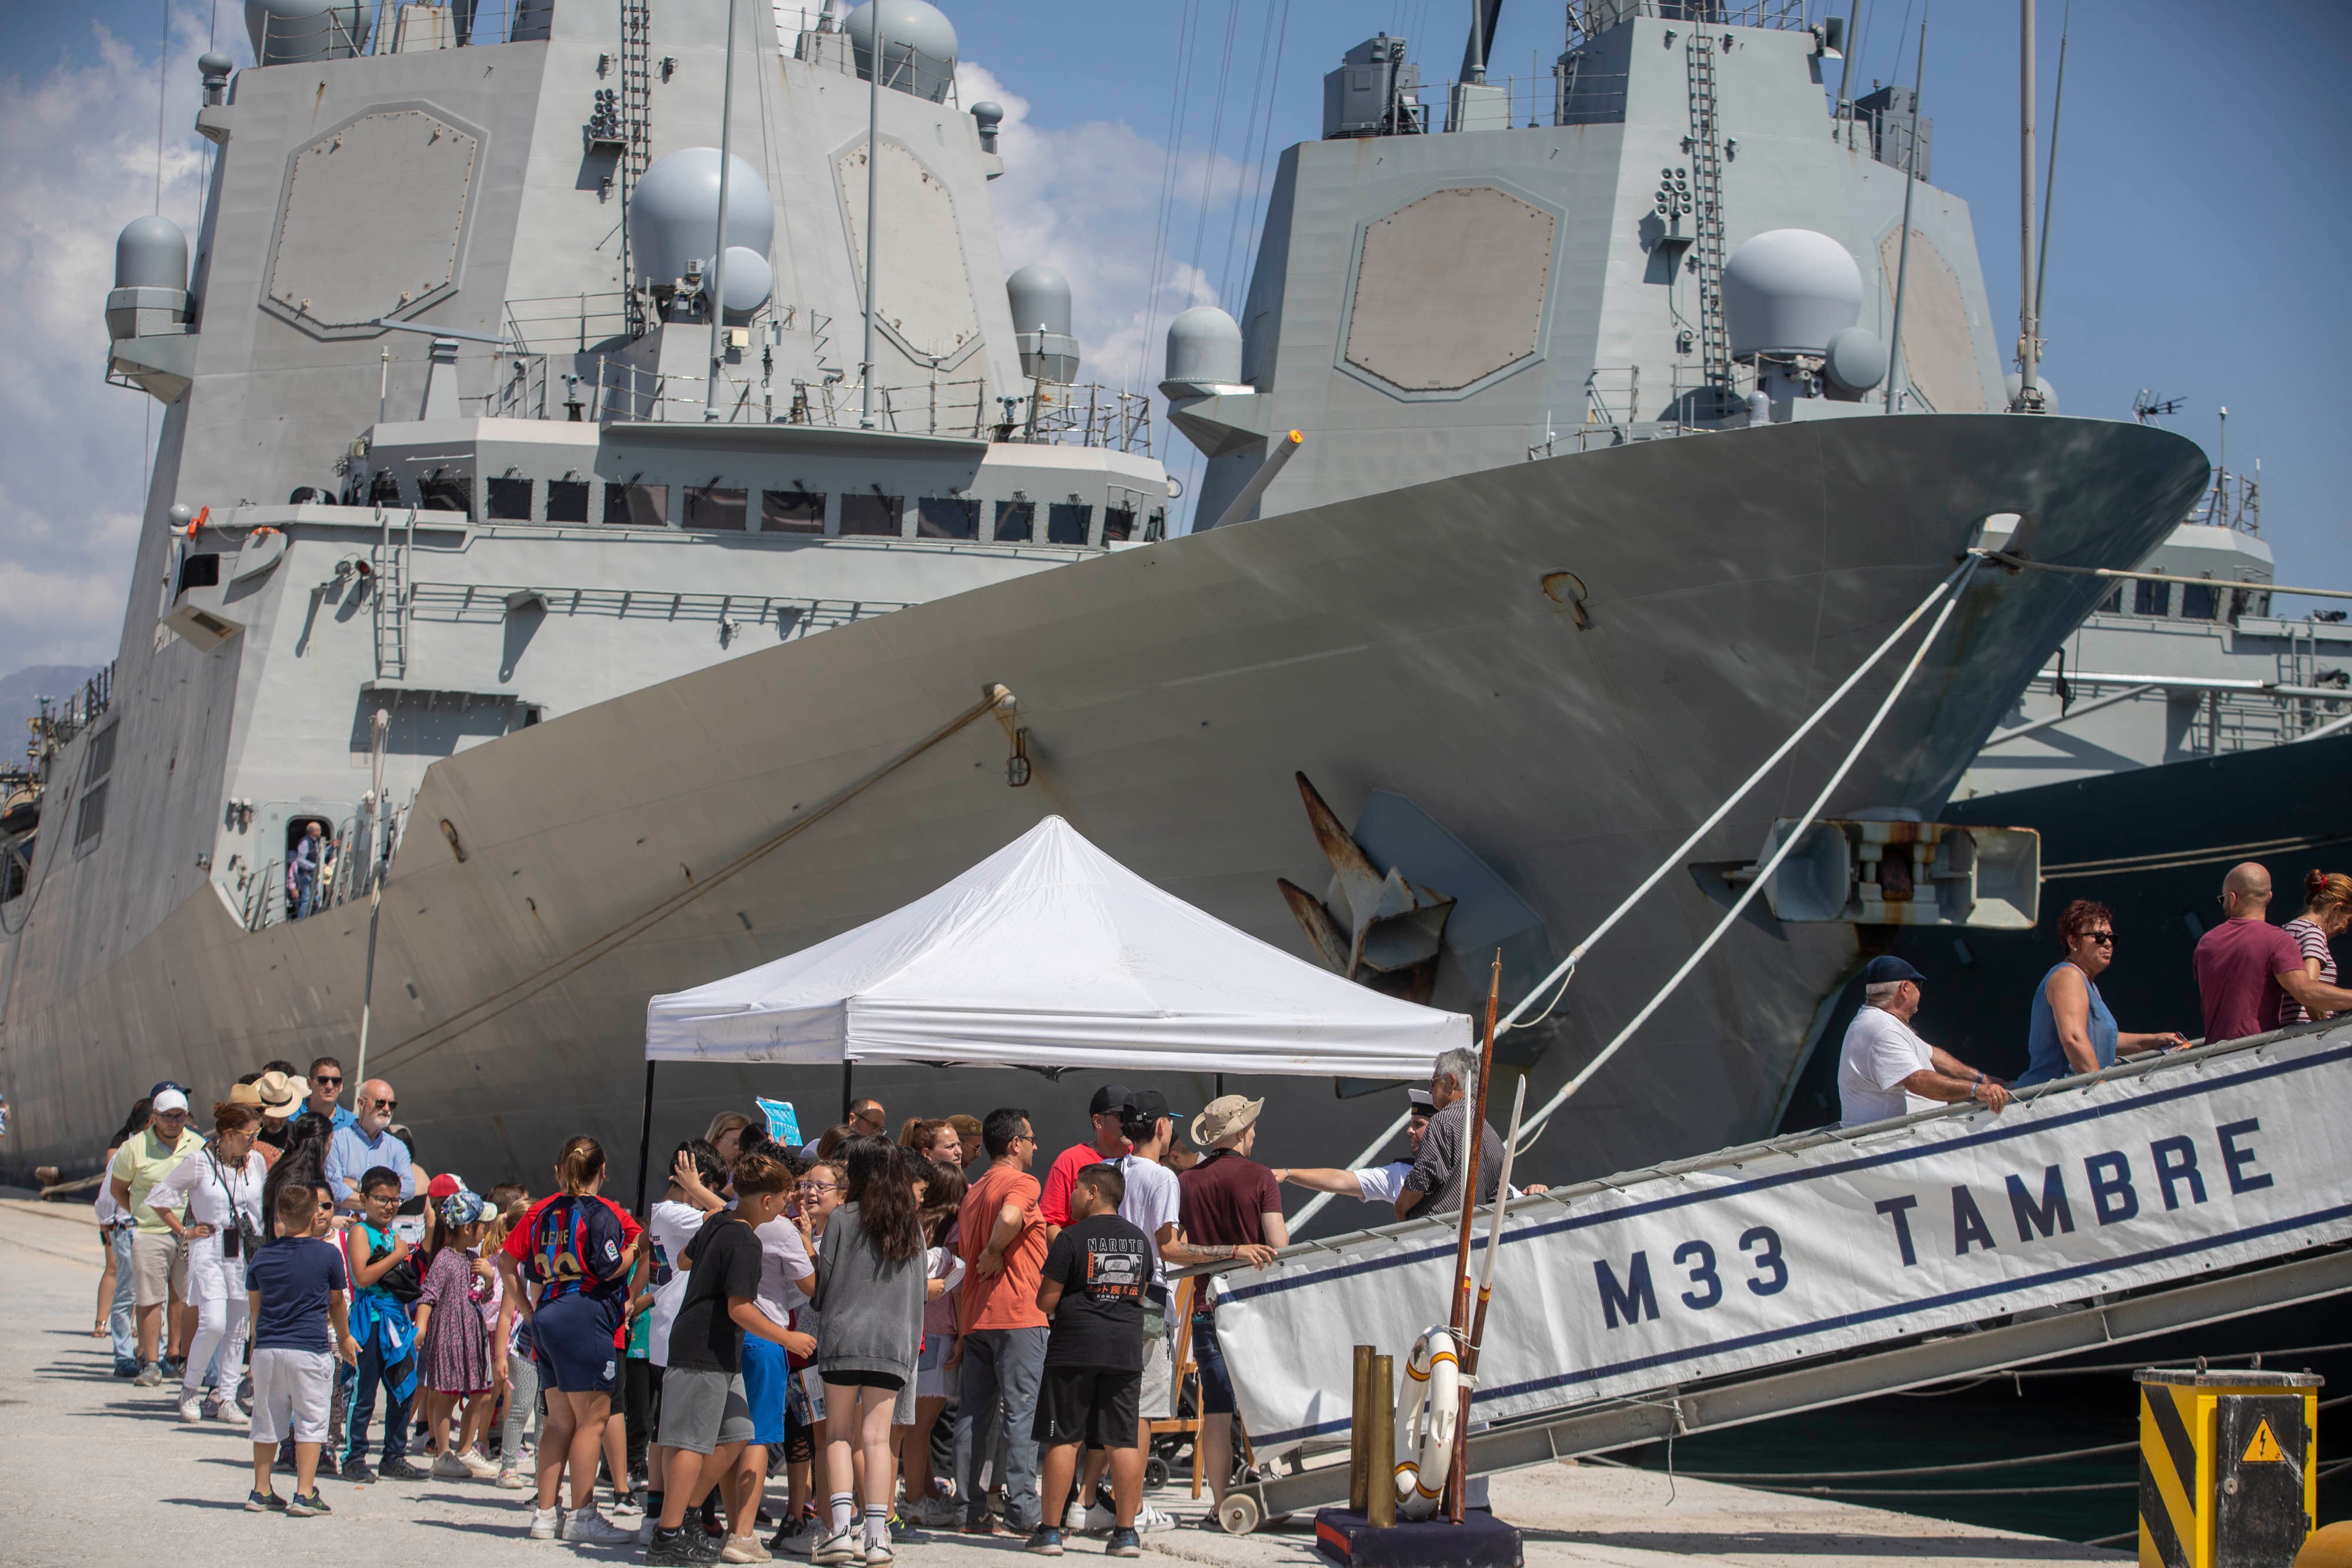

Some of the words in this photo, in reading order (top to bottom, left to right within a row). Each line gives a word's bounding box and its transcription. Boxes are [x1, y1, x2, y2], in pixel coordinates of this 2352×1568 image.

[1593, 1226, 1788, 1329] M33
[1874, 1117, 2274, 1266] TAMBRE
[541, 1229, 569, 1245] LEIRE
[1087, 1238, 1144, 1253] NARUTO
